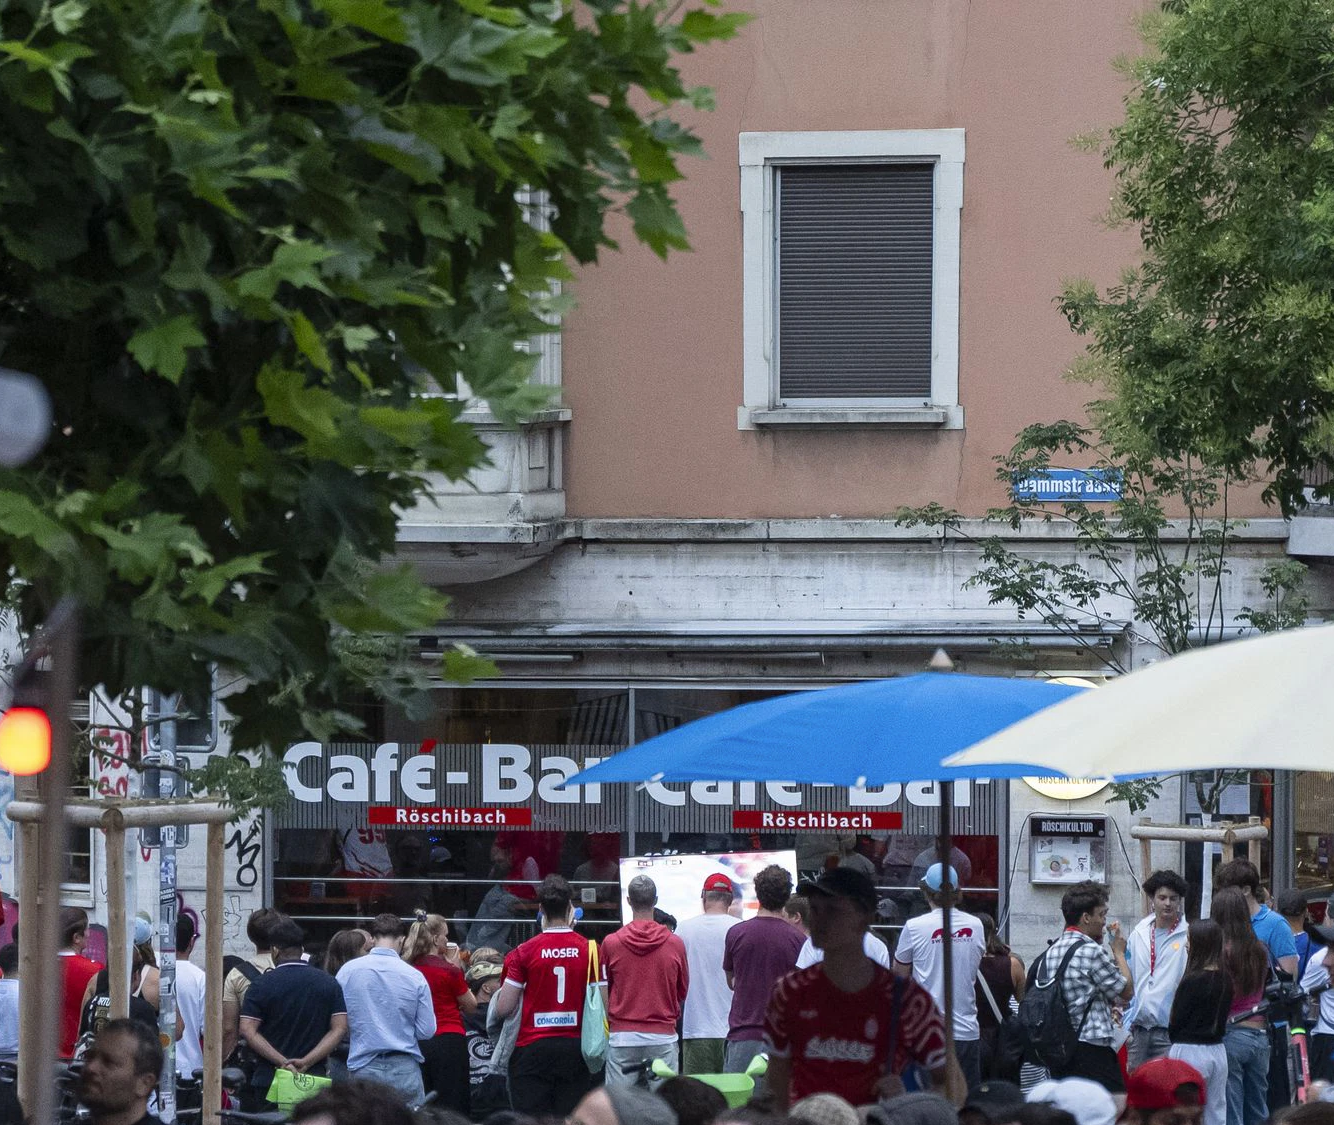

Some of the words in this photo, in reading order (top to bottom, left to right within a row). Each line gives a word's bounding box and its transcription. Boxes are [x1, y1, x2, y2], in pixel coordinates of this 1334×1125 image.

[282, 739, 611, 804] Café-Bar
[396, 808, 506, 824] Röschibach
[762, 812, 873, 828] Röschibach
[1041, 820, 1094, 833] RÖSCHIKULTUR
[542, 948, 579, 958] MOSER
[554, 967, 565, 1003] 1
